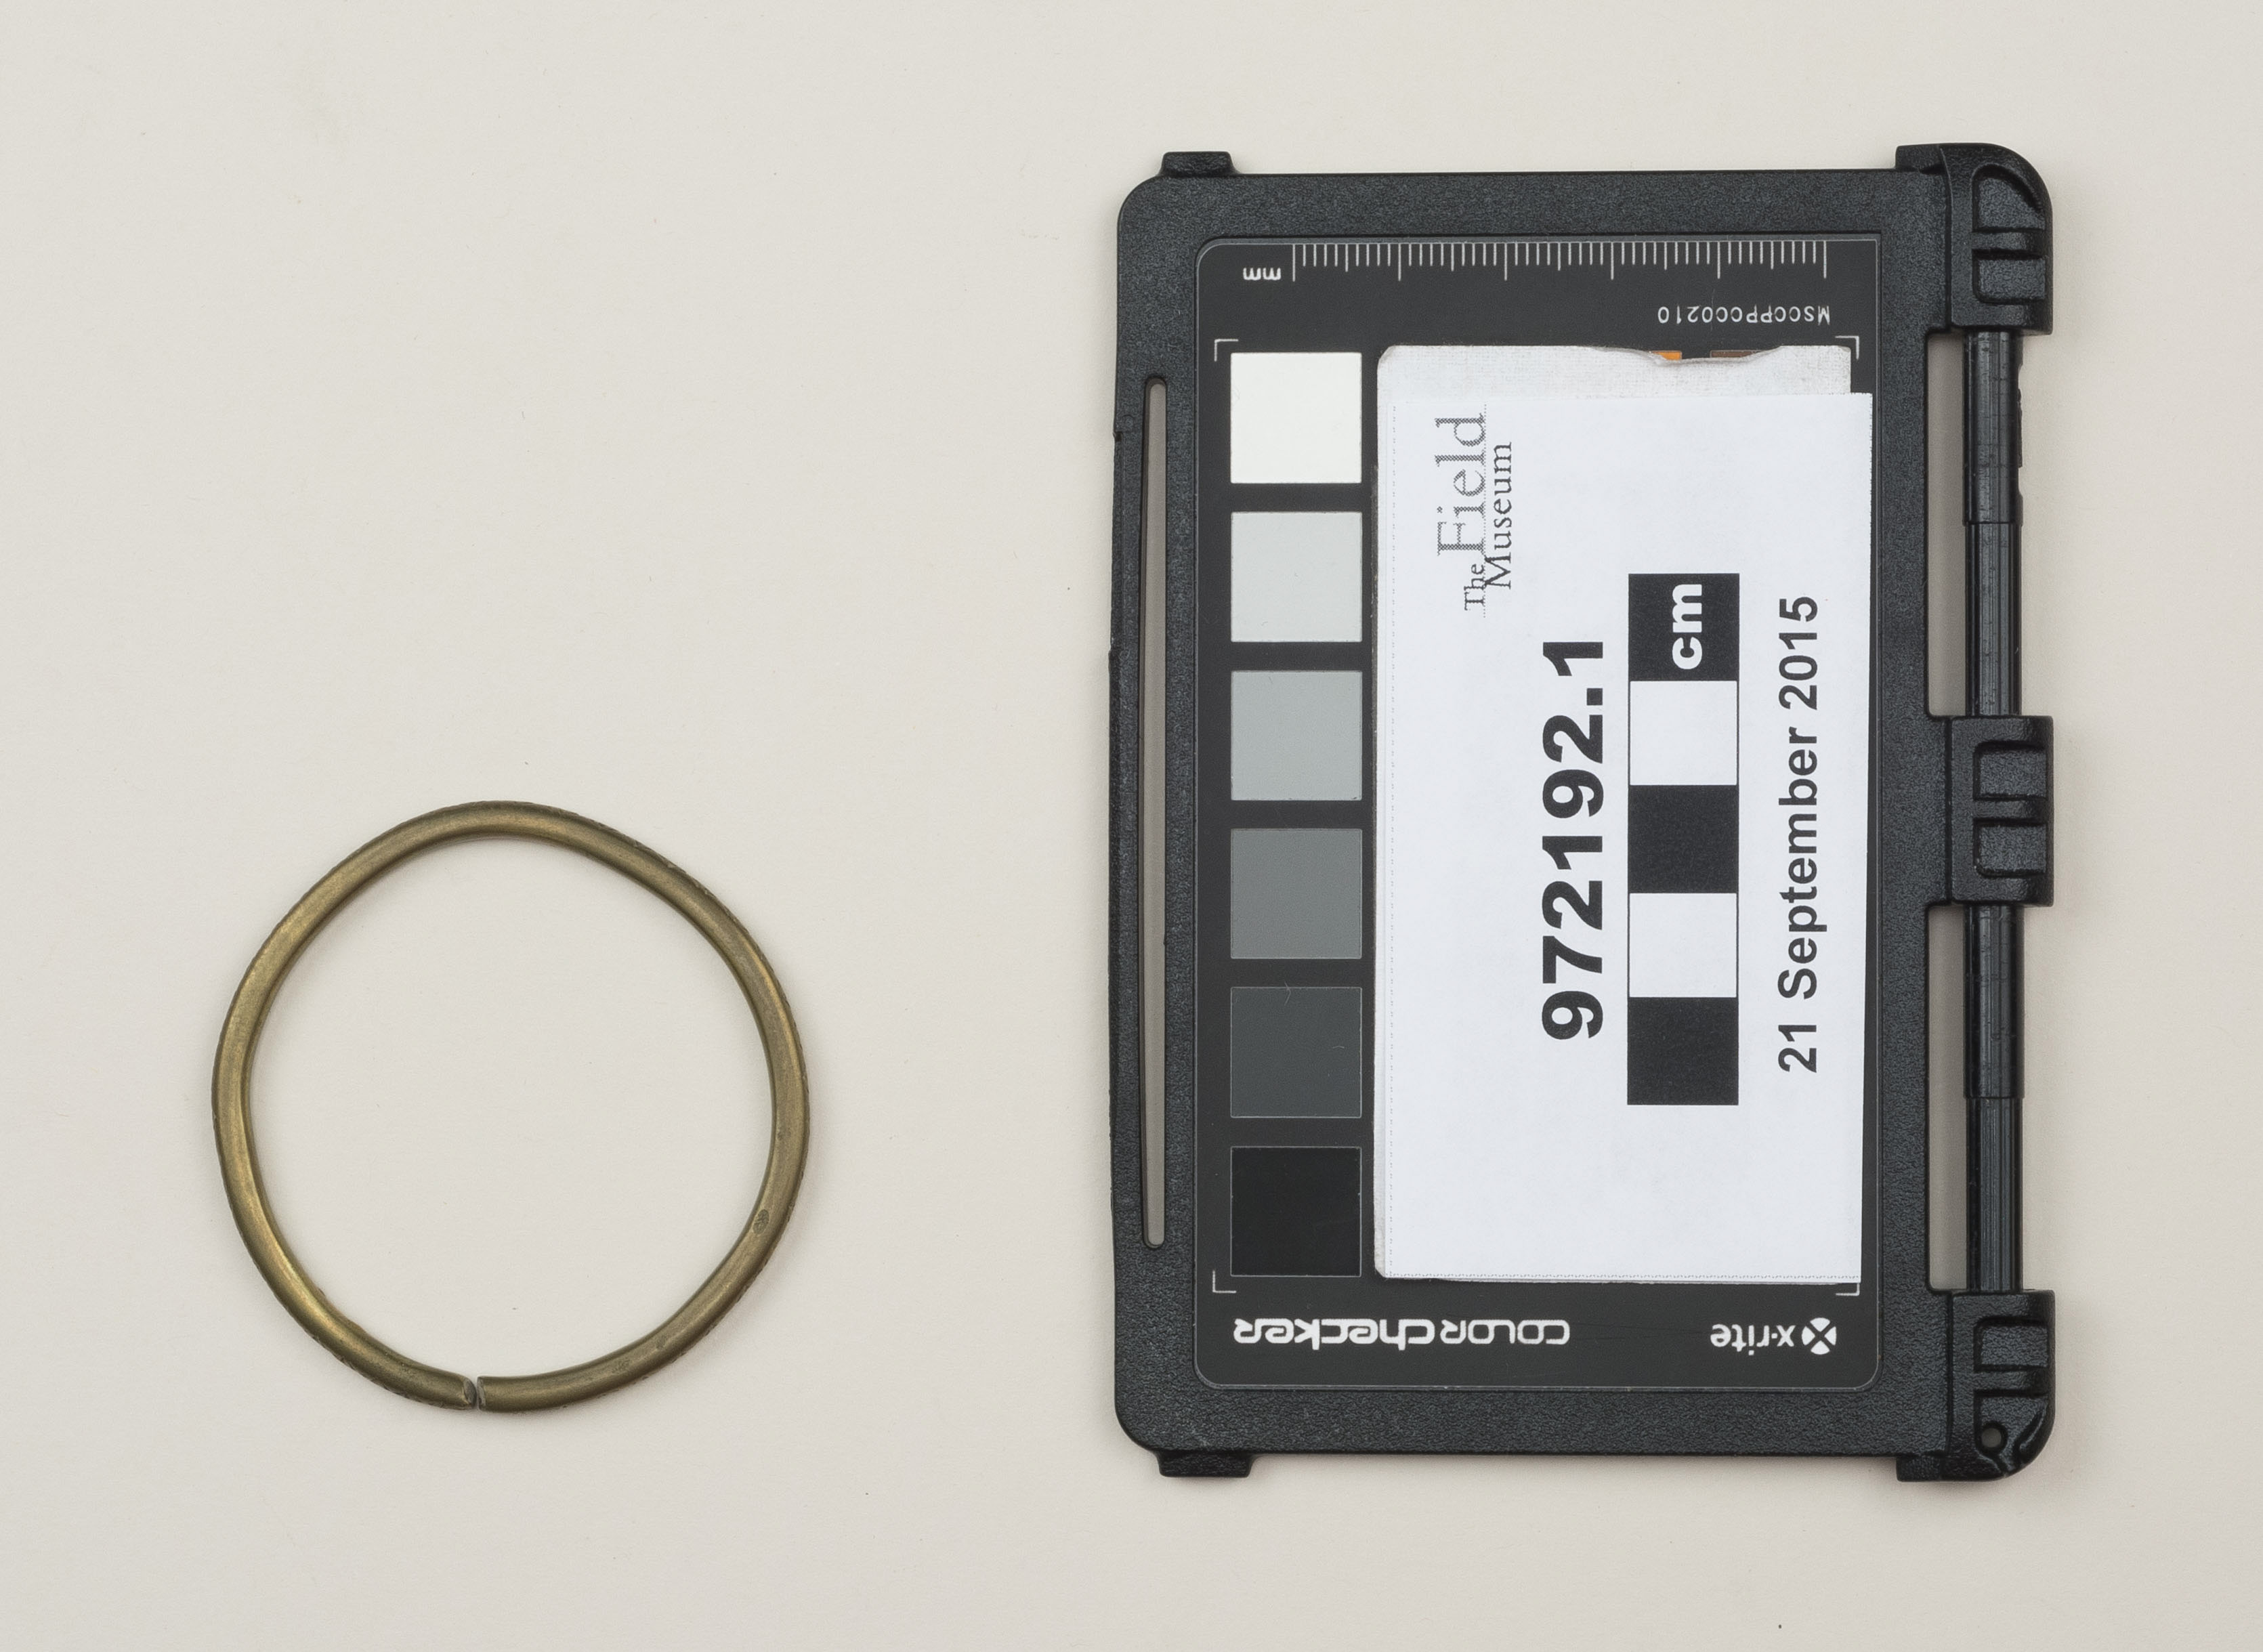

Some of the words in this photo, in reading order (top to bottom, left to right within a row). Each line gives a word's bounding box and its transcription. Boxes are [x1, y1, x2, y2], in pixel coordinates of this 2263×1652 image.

[1243, 267, 1282, 281] mm
[1435, 412, 1485, 555] Field
[1484, 442, 1512, 589] Museum
[1464, 564, 1485, 610] The
[1672, 584, 1703, 670] cm
[1778, 597, 1818, 710] 2015
[1542, 641, 1603, 1040] 972192.1
[1777, 727, 1827, 1000] September
[1778, 1025, 1817, 1073] 21
